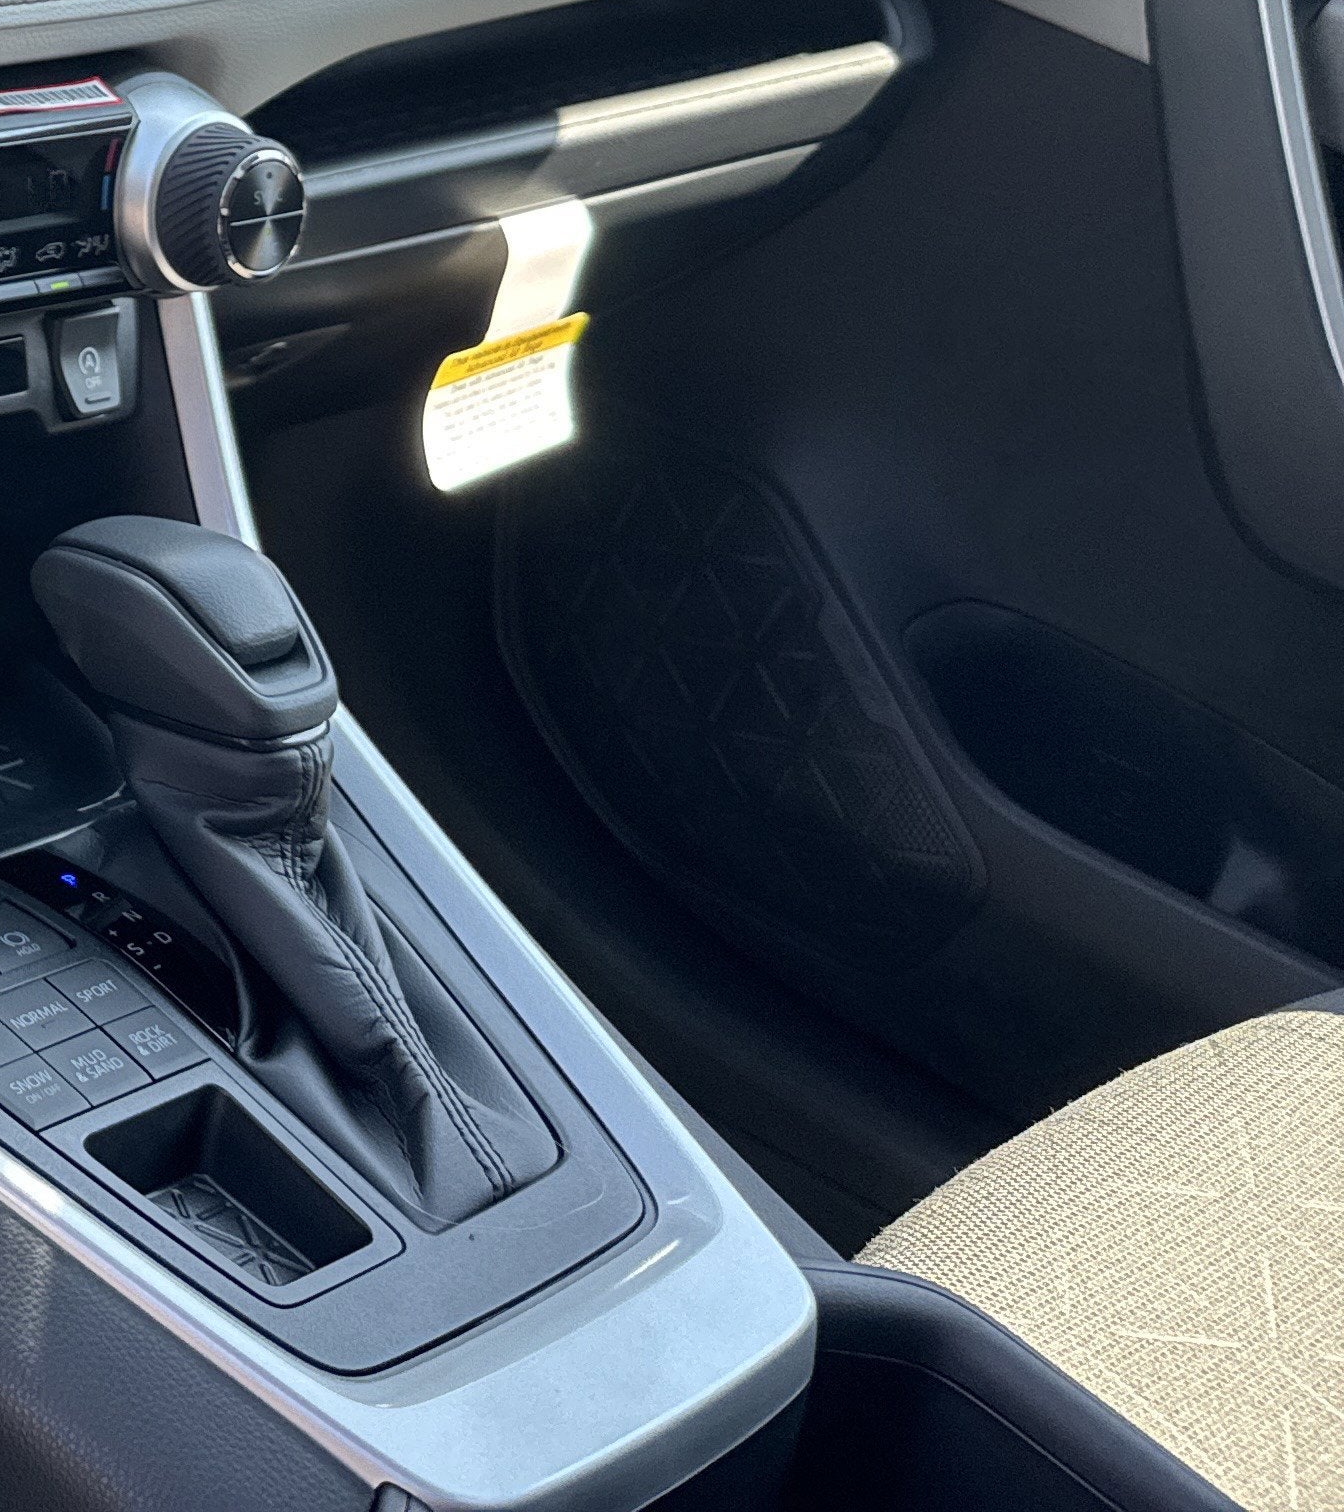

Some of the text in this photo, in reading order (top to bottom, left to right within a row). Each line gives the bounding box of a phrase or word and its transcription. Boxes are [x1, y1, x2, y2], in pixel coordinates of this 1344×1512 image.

[76, 979, 120, 1003] SPORT
[9, 1001, 69, 1030] NORMAL
[128, 1024, 166, 1045] ROCK
[137, 1033, 179, 1057] & DIRT
[70, 1048, 107, 1070] MUD
[75, 1056, 125, 1084] & SAND
[9, 1069, 53, 1095] SNOW
